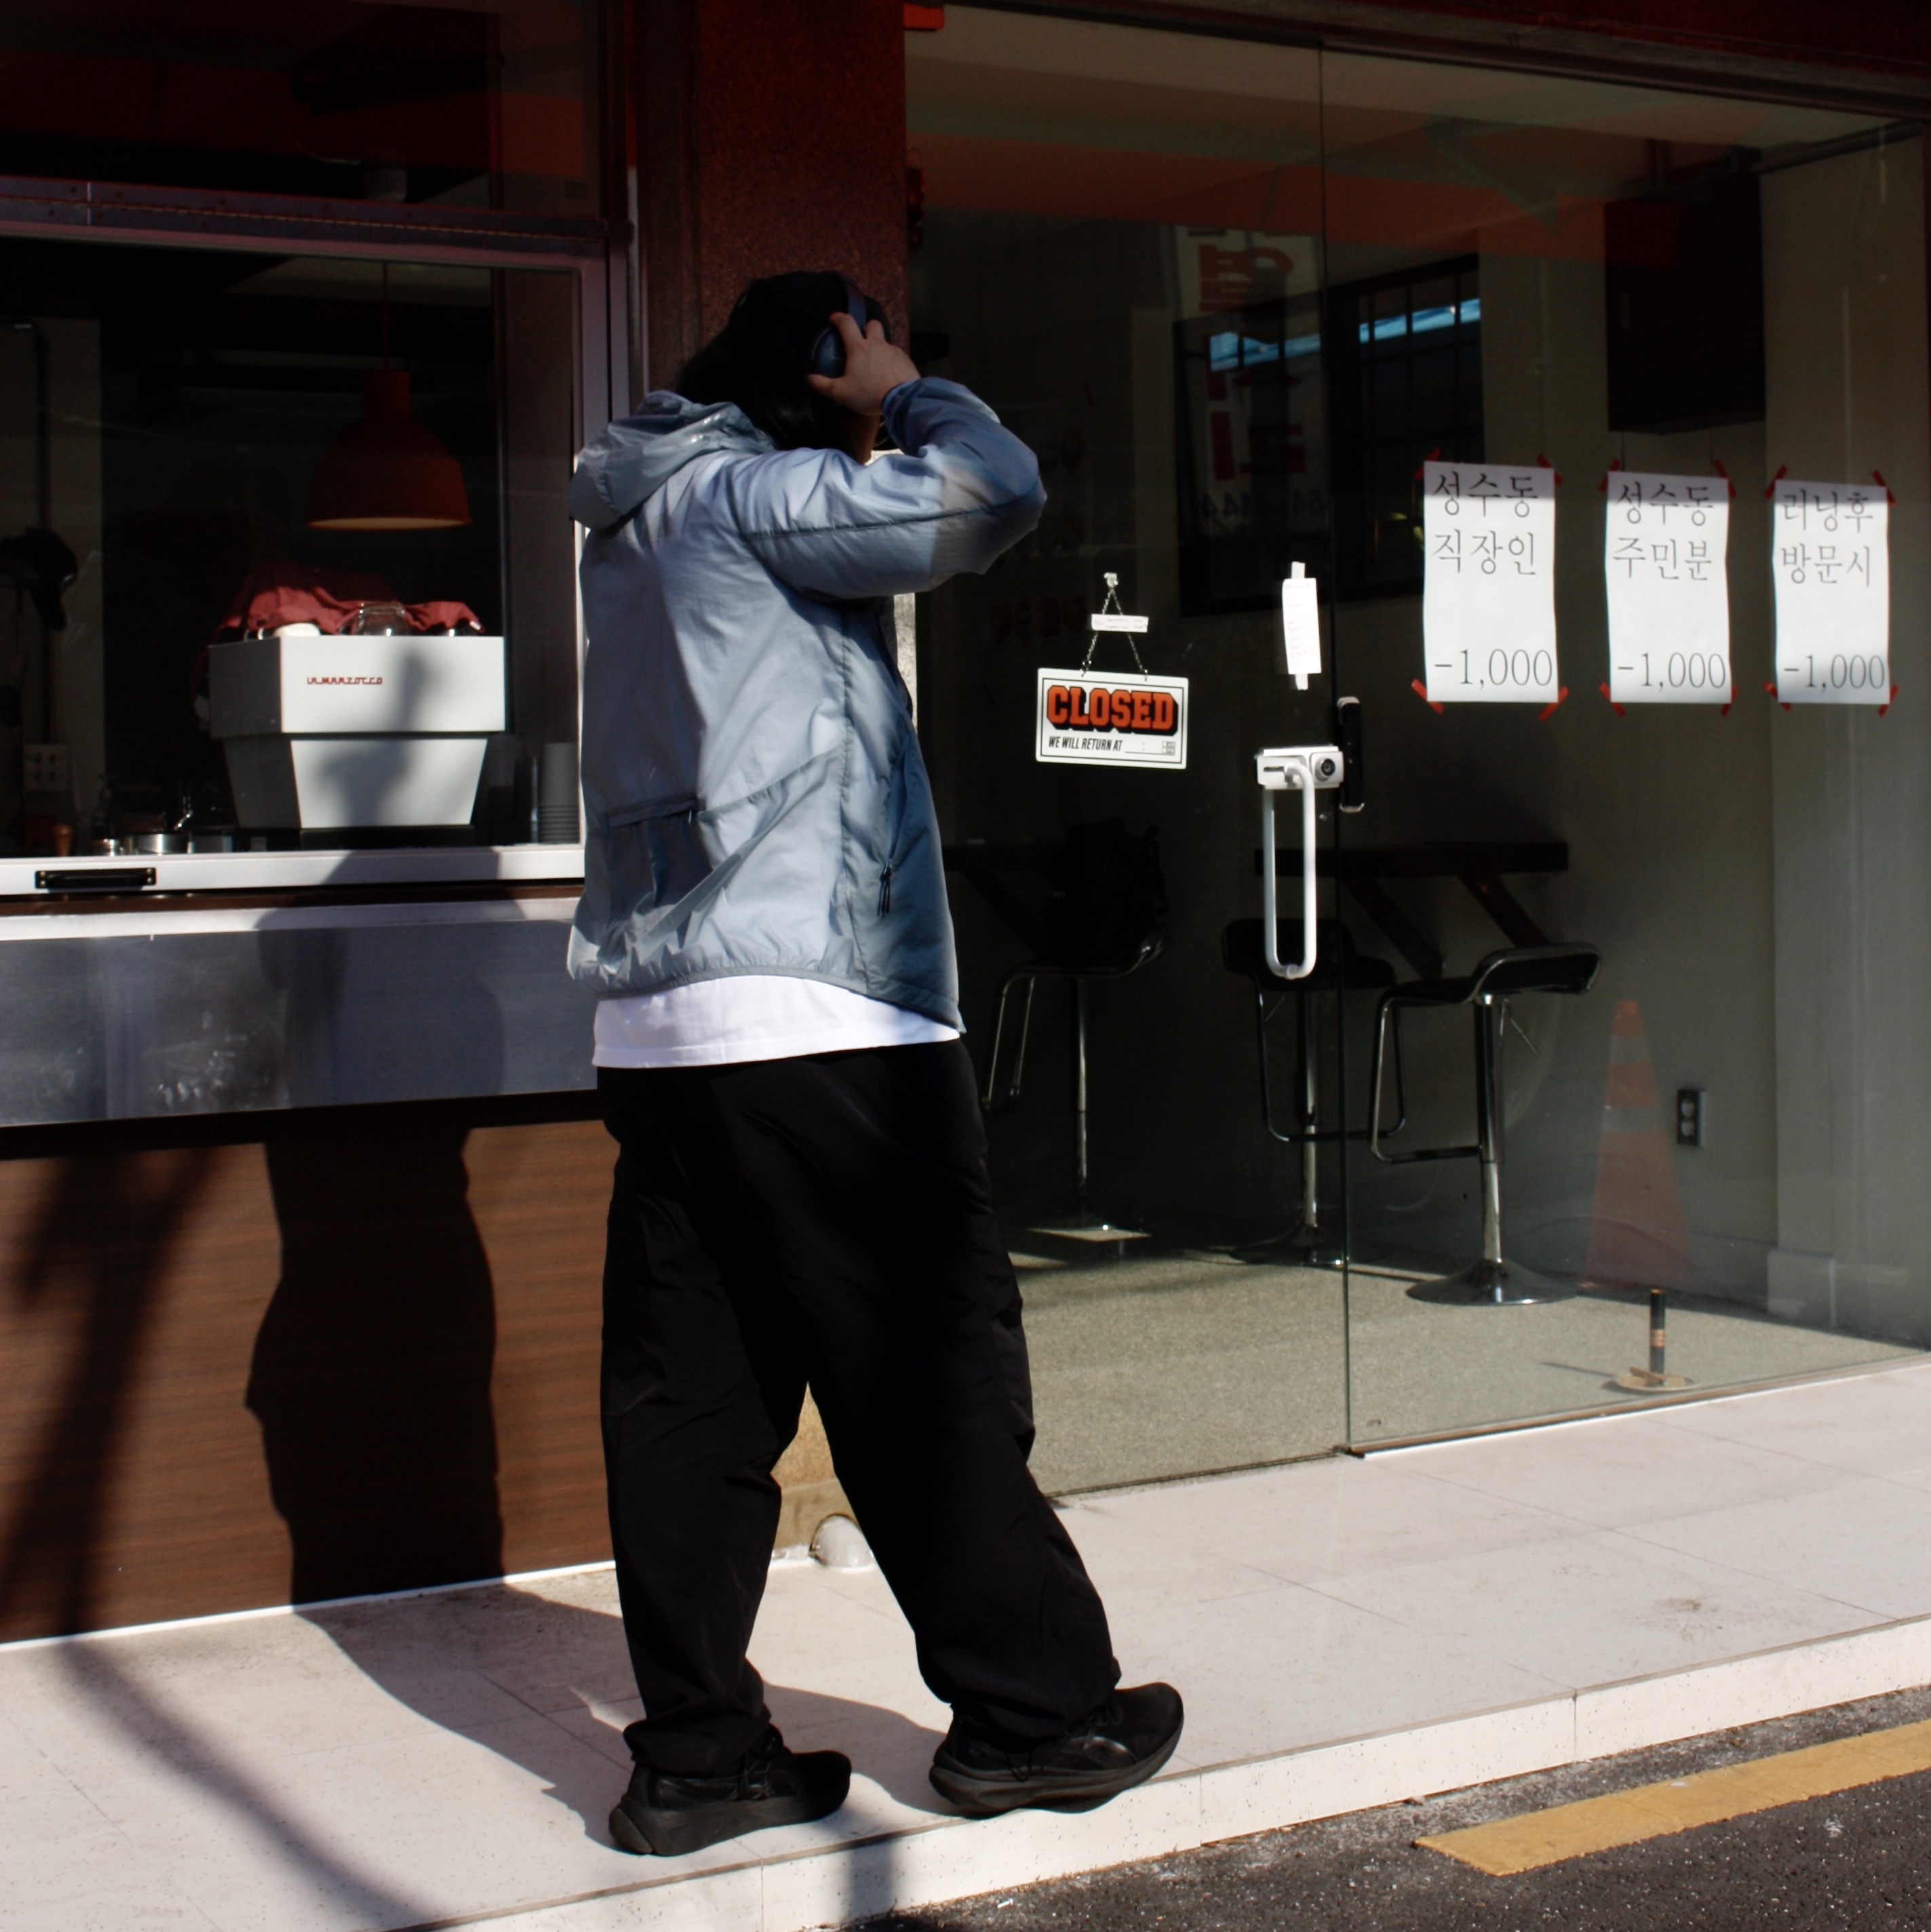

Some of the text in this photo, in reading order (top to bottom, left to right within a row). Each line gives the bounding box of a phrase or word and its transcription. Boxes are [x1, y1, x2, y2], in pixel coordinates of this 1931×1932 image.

[1432, 471, 1538, 518] 성수동
[1615, 481, 1714, 526] 성수동
[1432, 528, 1536, 574] 직장인
[1612, 538, 1712, 581] 주민분
[1781, 543, 1871, 588] 방문시
[1435, 648, 1553, 691] -1,000
[1618, 652, 1726, 692] -1,000
[1784, 654, 1885, 692] -1,000
[1047, 685, 1179, 736] CLOSED
[1049, 736, 1123, 751] WE WILL RETURN AT
